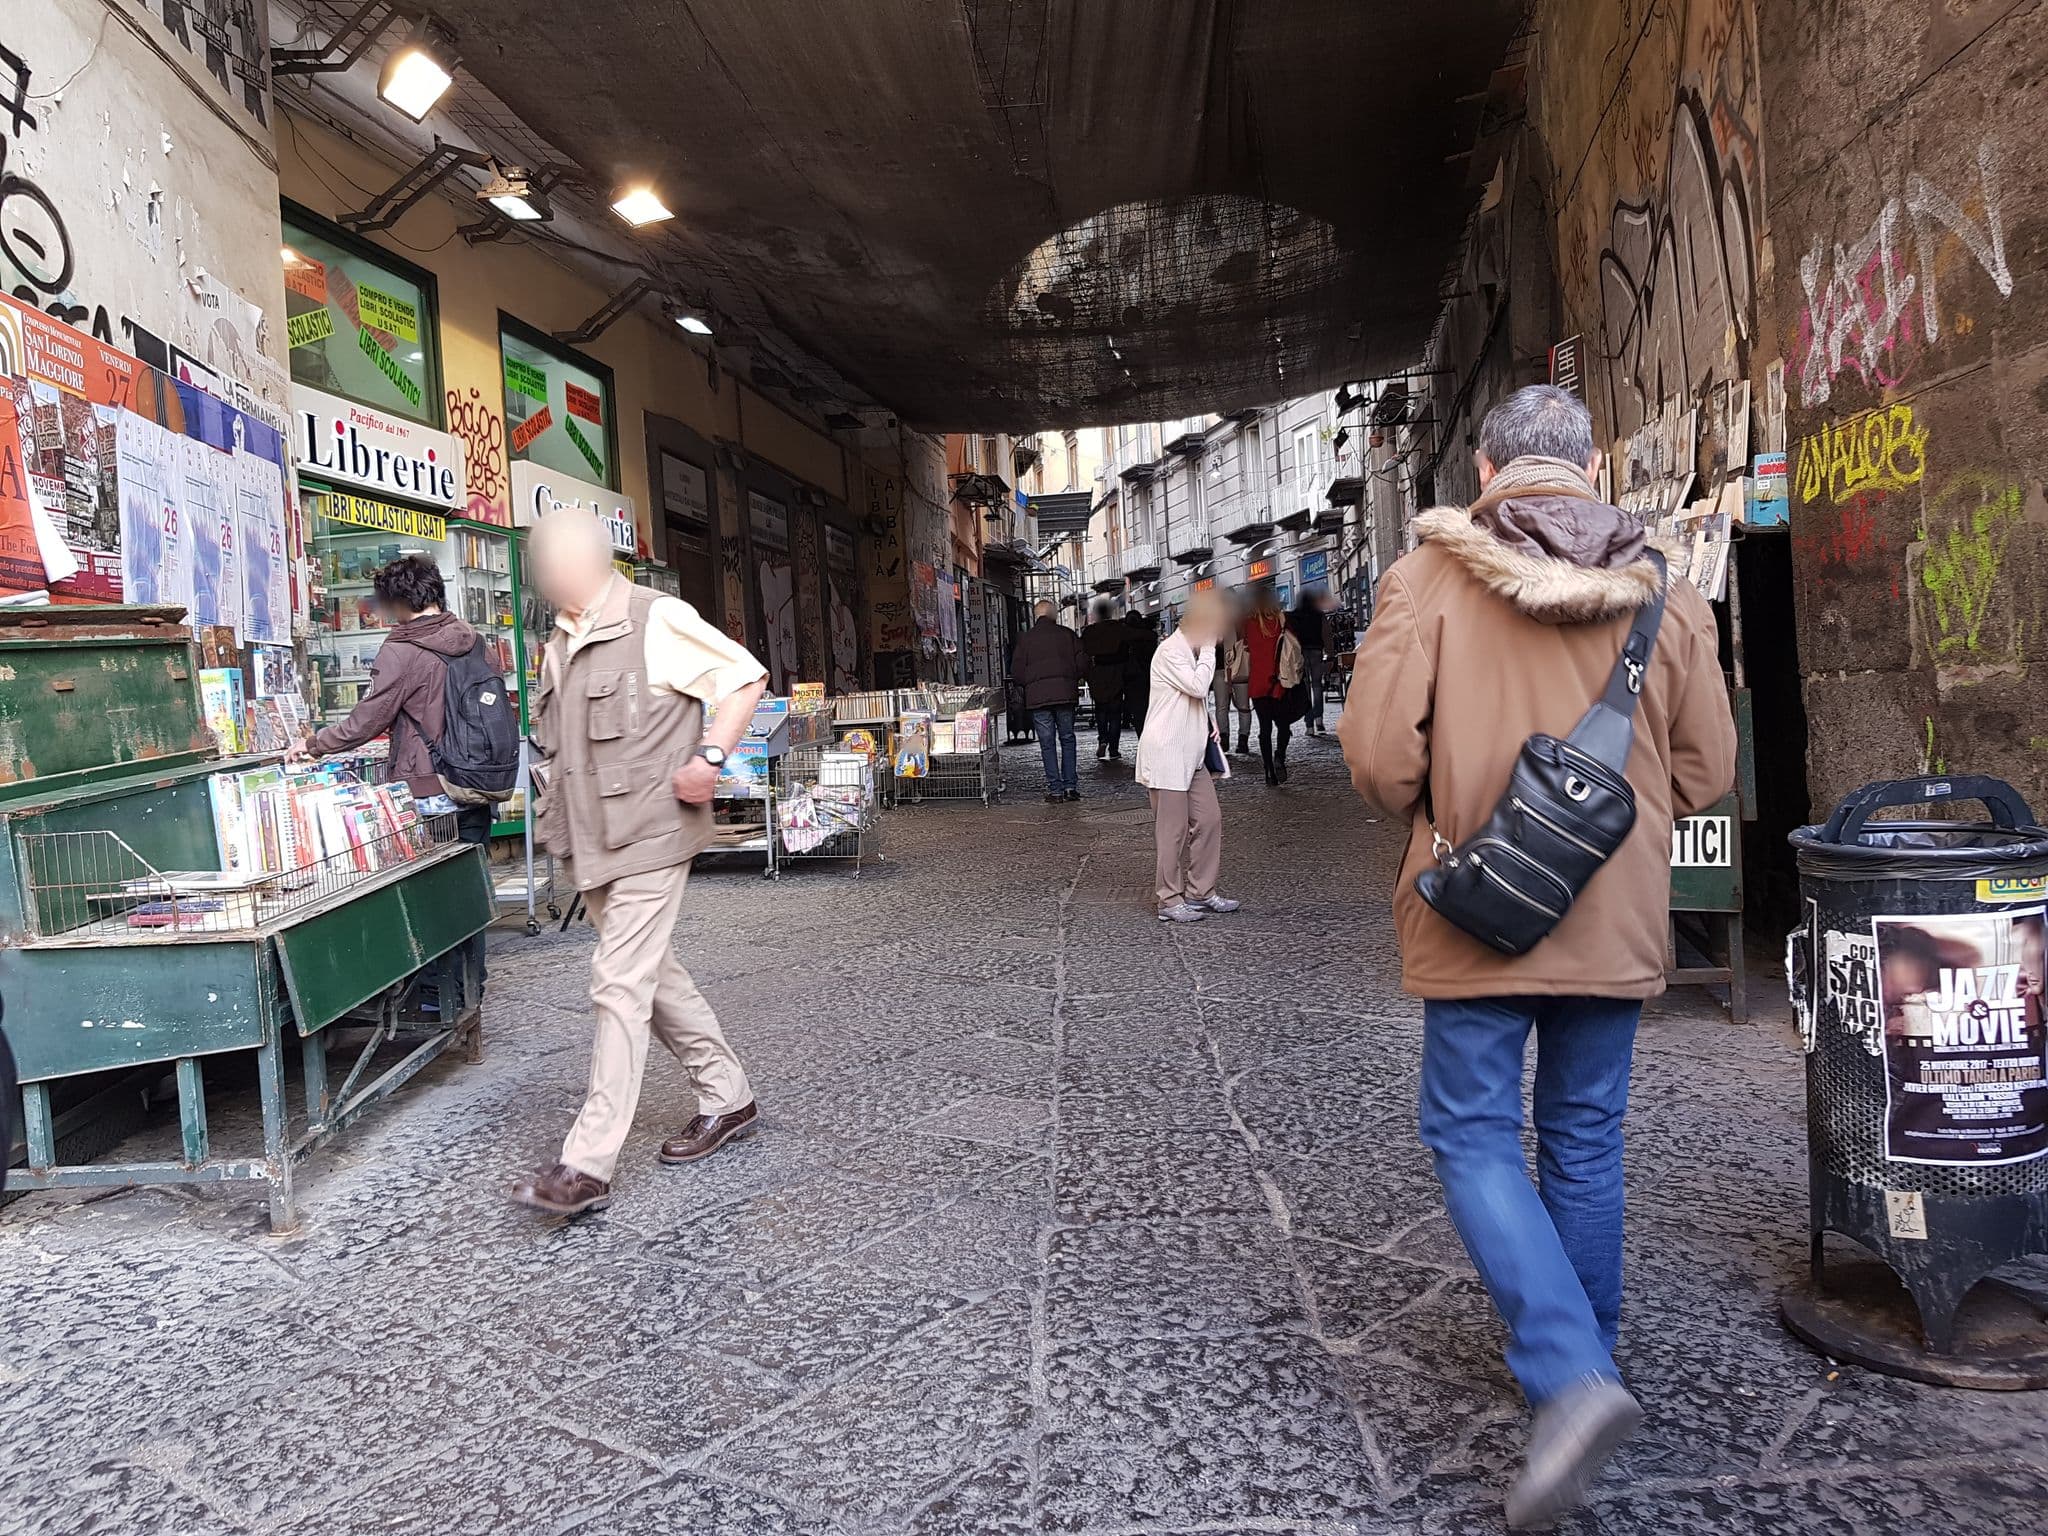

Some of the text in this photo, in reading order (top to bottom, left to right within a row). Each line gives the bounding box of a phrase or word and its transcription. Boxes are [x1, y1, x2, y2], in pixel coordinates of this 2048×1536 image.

[202, 292, 219, 309] VOTA
[359, 286, 415, 317] COMPRO E VENDO
[360, 301, 416, 330] LIBRI SCOLASTICI
[288, 310, 334, 347] SCOLASTICI
[377, 318, 401, 335] USATI
[24, 325, 84, 369] SAN LORENZO
[26, 346, 86, 391] MAGGIORE
[358, 327, 381, 361] LIBRI
[380, 352, 422, 408] SCOLASTICI
[106, 368, 130, 408] 27
[223, 377, 234, 399] LA
[350, 407, 410, 439] Pacifico dal 1967
[299, 411, 455, 500] Librerie
[164, 506, 178, 536] 26
[355, 498, 414, 534] SCOLASTICI
[416, 514, 443, 540] USATI
[870, 476, 884, 577] LIBRIA
[885, 479, 898, 548] ALBA
[0, 534, 17, 552] The
[221, 524, 233, 550] 26
[270, 532, 281, 555] 26
[794, 689, 823, 698] MOSTRI
[1674, 819, 1727, 864] TICI
[1926, 964, 2025, 1013] JAZZ
[1931, 1008, 2028, 1046] MOVIE
[1920, 1060, 1931, 1070] 25
[1921, 1070, 1961, 1084] ULTIMO
[1963, 1069, 1998, 1083] TANGO
[1999, 1069, 2007, 1082] A
